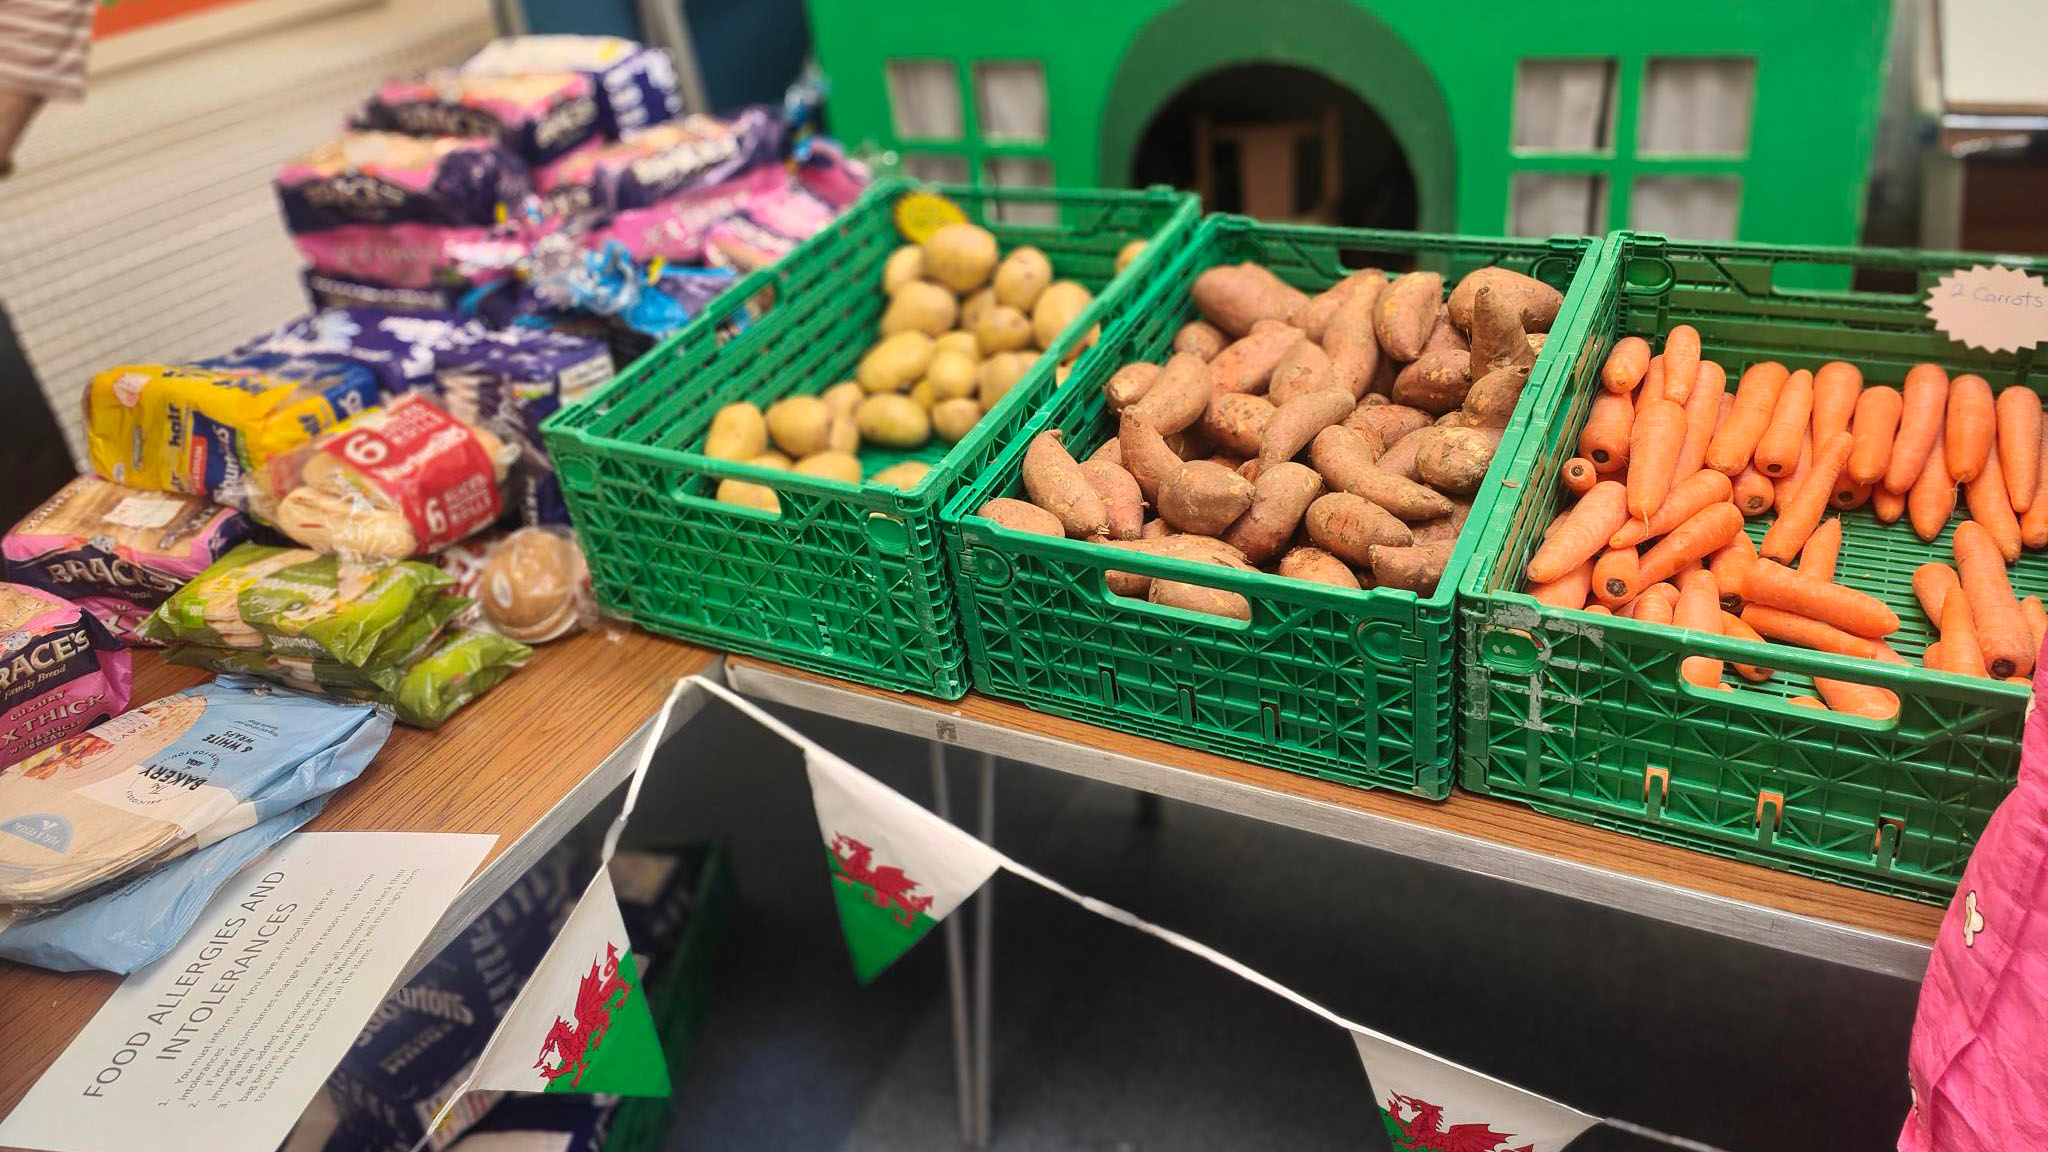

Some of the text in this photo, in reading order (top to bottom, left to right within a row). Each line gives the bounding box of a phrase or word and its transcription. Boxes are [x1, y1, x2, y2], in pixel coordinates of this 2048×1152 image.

[1972, 287, 2045, 308] Carrots
[344, 432, 389, 466] 6
[426, 496, 449, 535] 6
[0, 628, 91, 690] RACE'S
[3, 663, 68, 700] Family Bread
[10, 690, 67, 722] LUXURY
[20, 693, 107, 735] THICK
[29, 730, 67, 752] BREAD
[201, 733, 242, 752] WHITE
[222, 730, 256, 745] WRAPS
[138, 764, 209, 791] BAKERY
[82, 871, 285, 1098] FOOD ALLERGIES AND
[155, 902, 298, 1060] INTOLERANCES
[174, 1067, 193, 1085] You
[191, 1045, 212, 1066] must
[208, 1015, 235, 1043] inform
[232, 1004, 244, 1015] us
[247, 980, 262, 997] you
[256, 960, 278, 981] have
[277, 945, 291, 961] any
[285, 926, 305, 945] food
[301, 896, 330, 927] allergies
[212, 1058, 232, 1079] your
[230, 998, 278, 1057] circumstances
[274, 968, 303, 998] change
[296, 955, 310, 969] for
[309, 940, 324, 957] any
[339, 901, 353, 913] let
[355, 872, 376, 892] know
[235, 1075, 250, 1088] As
[246, 1062, 258, 1075] an
[256, 1034, 280, 1062] added
[277, 986, 315, 1034] precaution
[311, 975, 326, 989] we
[321, 960, 336, 976] ask
[340, 914, 371, 950] members
[374, 885, 394, 906] check
[387, 867, 408, 886] their
[238, 1083, 259, 1103] bag
[251, 1054, 281, 1084] before
[274, 1022, 306, 1053] leaving
[299, 1008, 314, 1023] the
[311, 978, 337, 1007] centre.
[334, 938, 367, 979] Members
[363, 921, 380, 938] will
[374, 906, 392, 923] then
[402, 867, 421, 886] form
[253, 1091, 268, 1103] to
[263, 1075, 281, 1091] say
[274, 1054, 298, 1075] they
[289, 1032, 312, 1054] have
[308, 996, 338, 1032] checked
[342, 969, 356, 986] the
[178, 1045, 228, 1101] intolerances.
[208, 1047, 256, 1101] immediately
